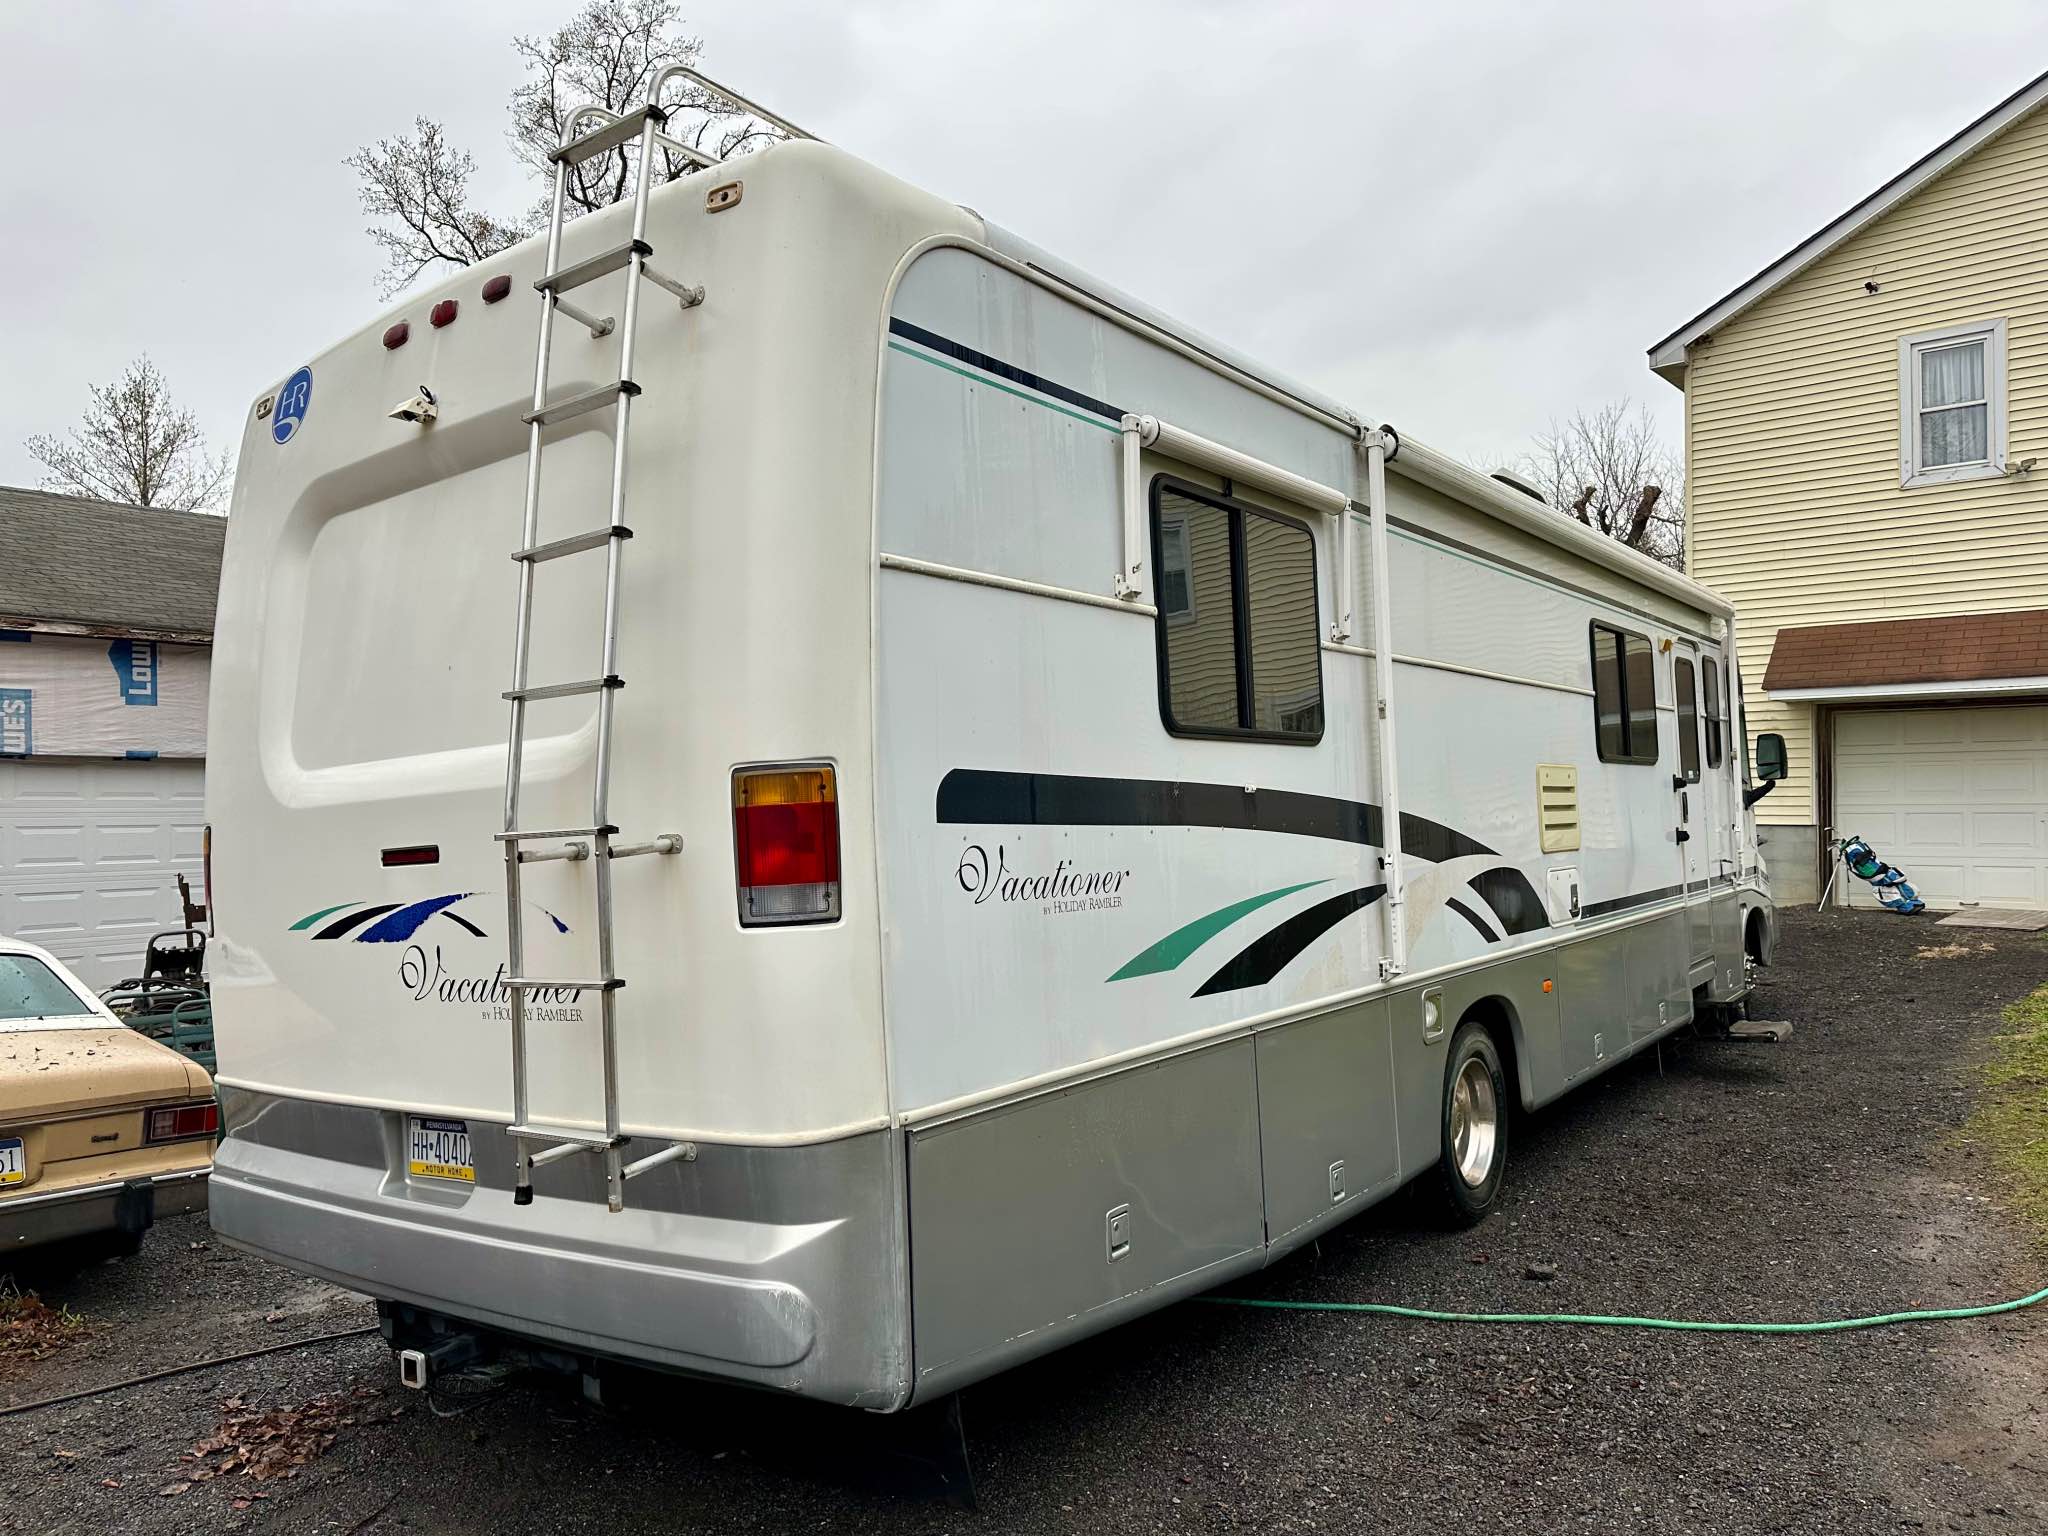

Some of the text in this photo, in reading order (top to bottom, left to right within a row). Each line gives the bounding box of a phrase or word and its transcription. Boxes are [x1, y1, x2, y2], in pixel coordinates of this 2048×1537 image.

[955, 845, 1130, 905] Vacationer
[1089, 896, 1122, 910] RAMBLER
[398, 944, 583, 1004] Vacatiner
[481, 1006, 584, 1021] BY HOLAY RAMBLER
[425, 1165, 463, 1177] MOTOR HOME
